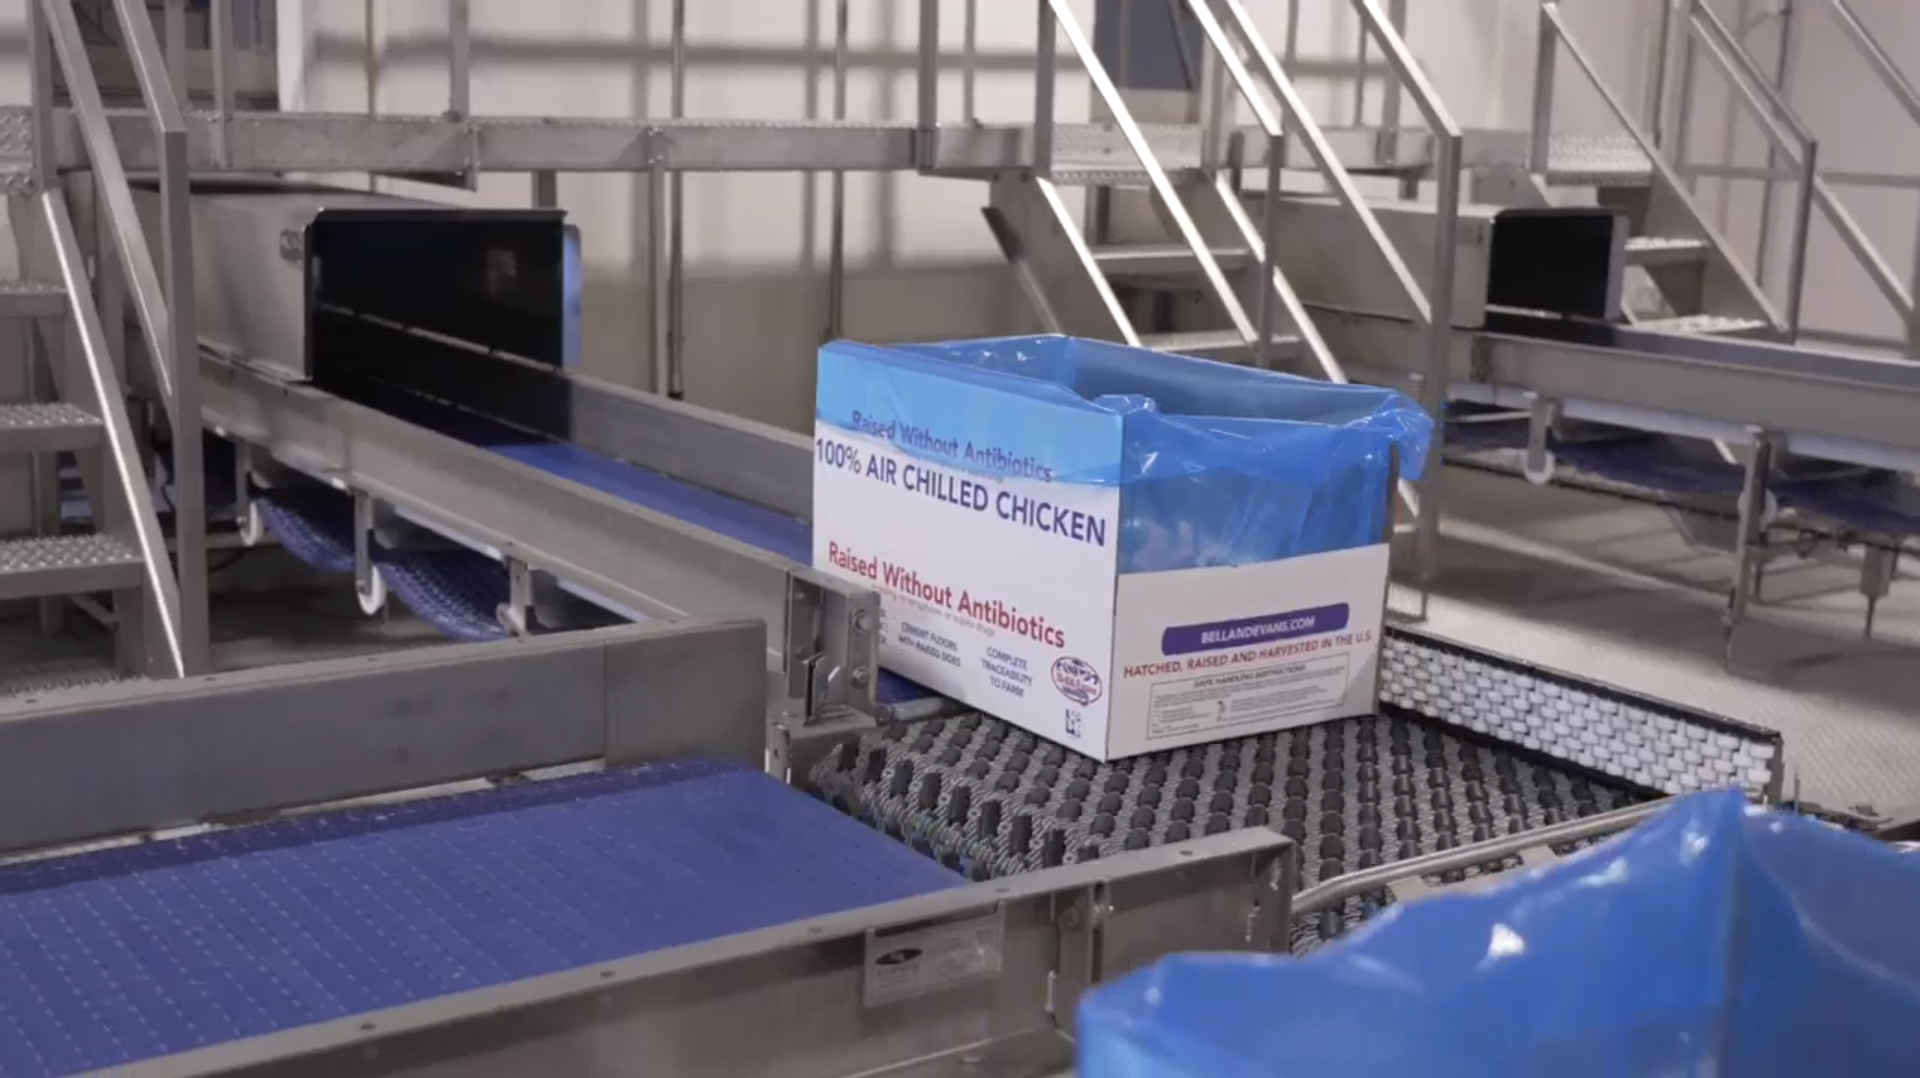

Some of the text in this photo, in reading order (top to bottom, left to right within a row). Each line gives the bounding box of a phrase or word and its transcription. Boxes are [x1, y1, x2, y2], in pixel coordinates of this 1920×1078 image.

[852, 410, 897, 440] Raised
[900, 423, 959, 457] Without
[964, 441, 1052, 483] Antibiotics
[816, 438, 862, 474] 100%
[866, 454, 897, 486] AIR
[903, 464, 988, 511] CHILLED
[996, 491, 1106, 546] CHICKEN
[829, 541, 878, 580] Raised
[882, 561, 953, 609] Without
[958, 590, 1065, 649] Antibiotics
[1200, 616, 1316, 644] BELLANDEVANS.COM
[941, 651, 961, 667] SIDES
[986, 646, 1028, 670] COMPLETE
[1123, 629, 1372, 678] HATCHED, RAISED AND HARVESTED IN THE U.S.
[981, 658, 1032, 687] TRACEABILITY
[990, 675, 1004, 690] TO
[1254, 664, 1306, 679] INSTRUCTIONS
